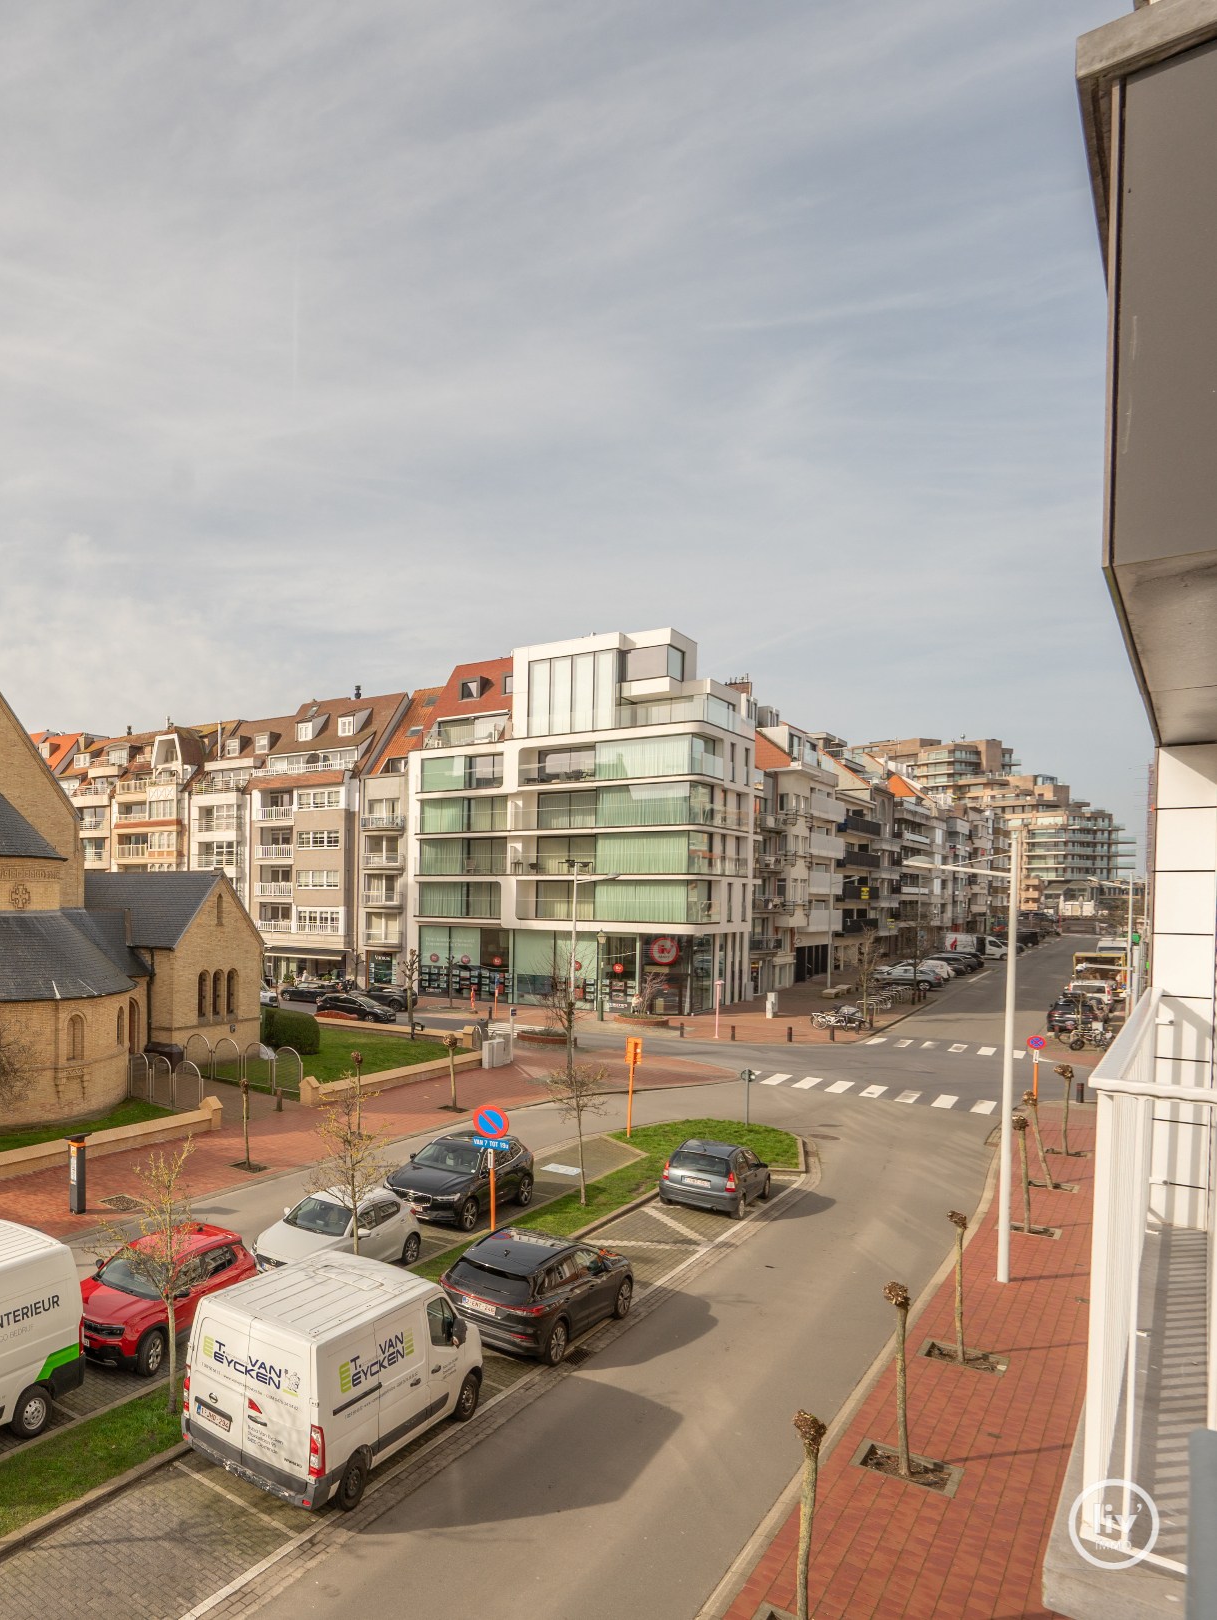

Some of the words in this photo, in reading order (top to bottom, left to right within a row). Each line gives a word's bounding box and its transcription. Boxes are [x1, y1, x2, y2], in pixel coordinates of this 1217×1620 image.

[214, 1351, 281, 1389] EYCKEN
[215, 1340, 225, 1354] T.
[249, 1356, 282, 1378] VAN
[350, 1355, 362, 1370] T.
[379, 1332, 404, 1355] VAN
[351, 1346, 405, 1387] EYCKEN
